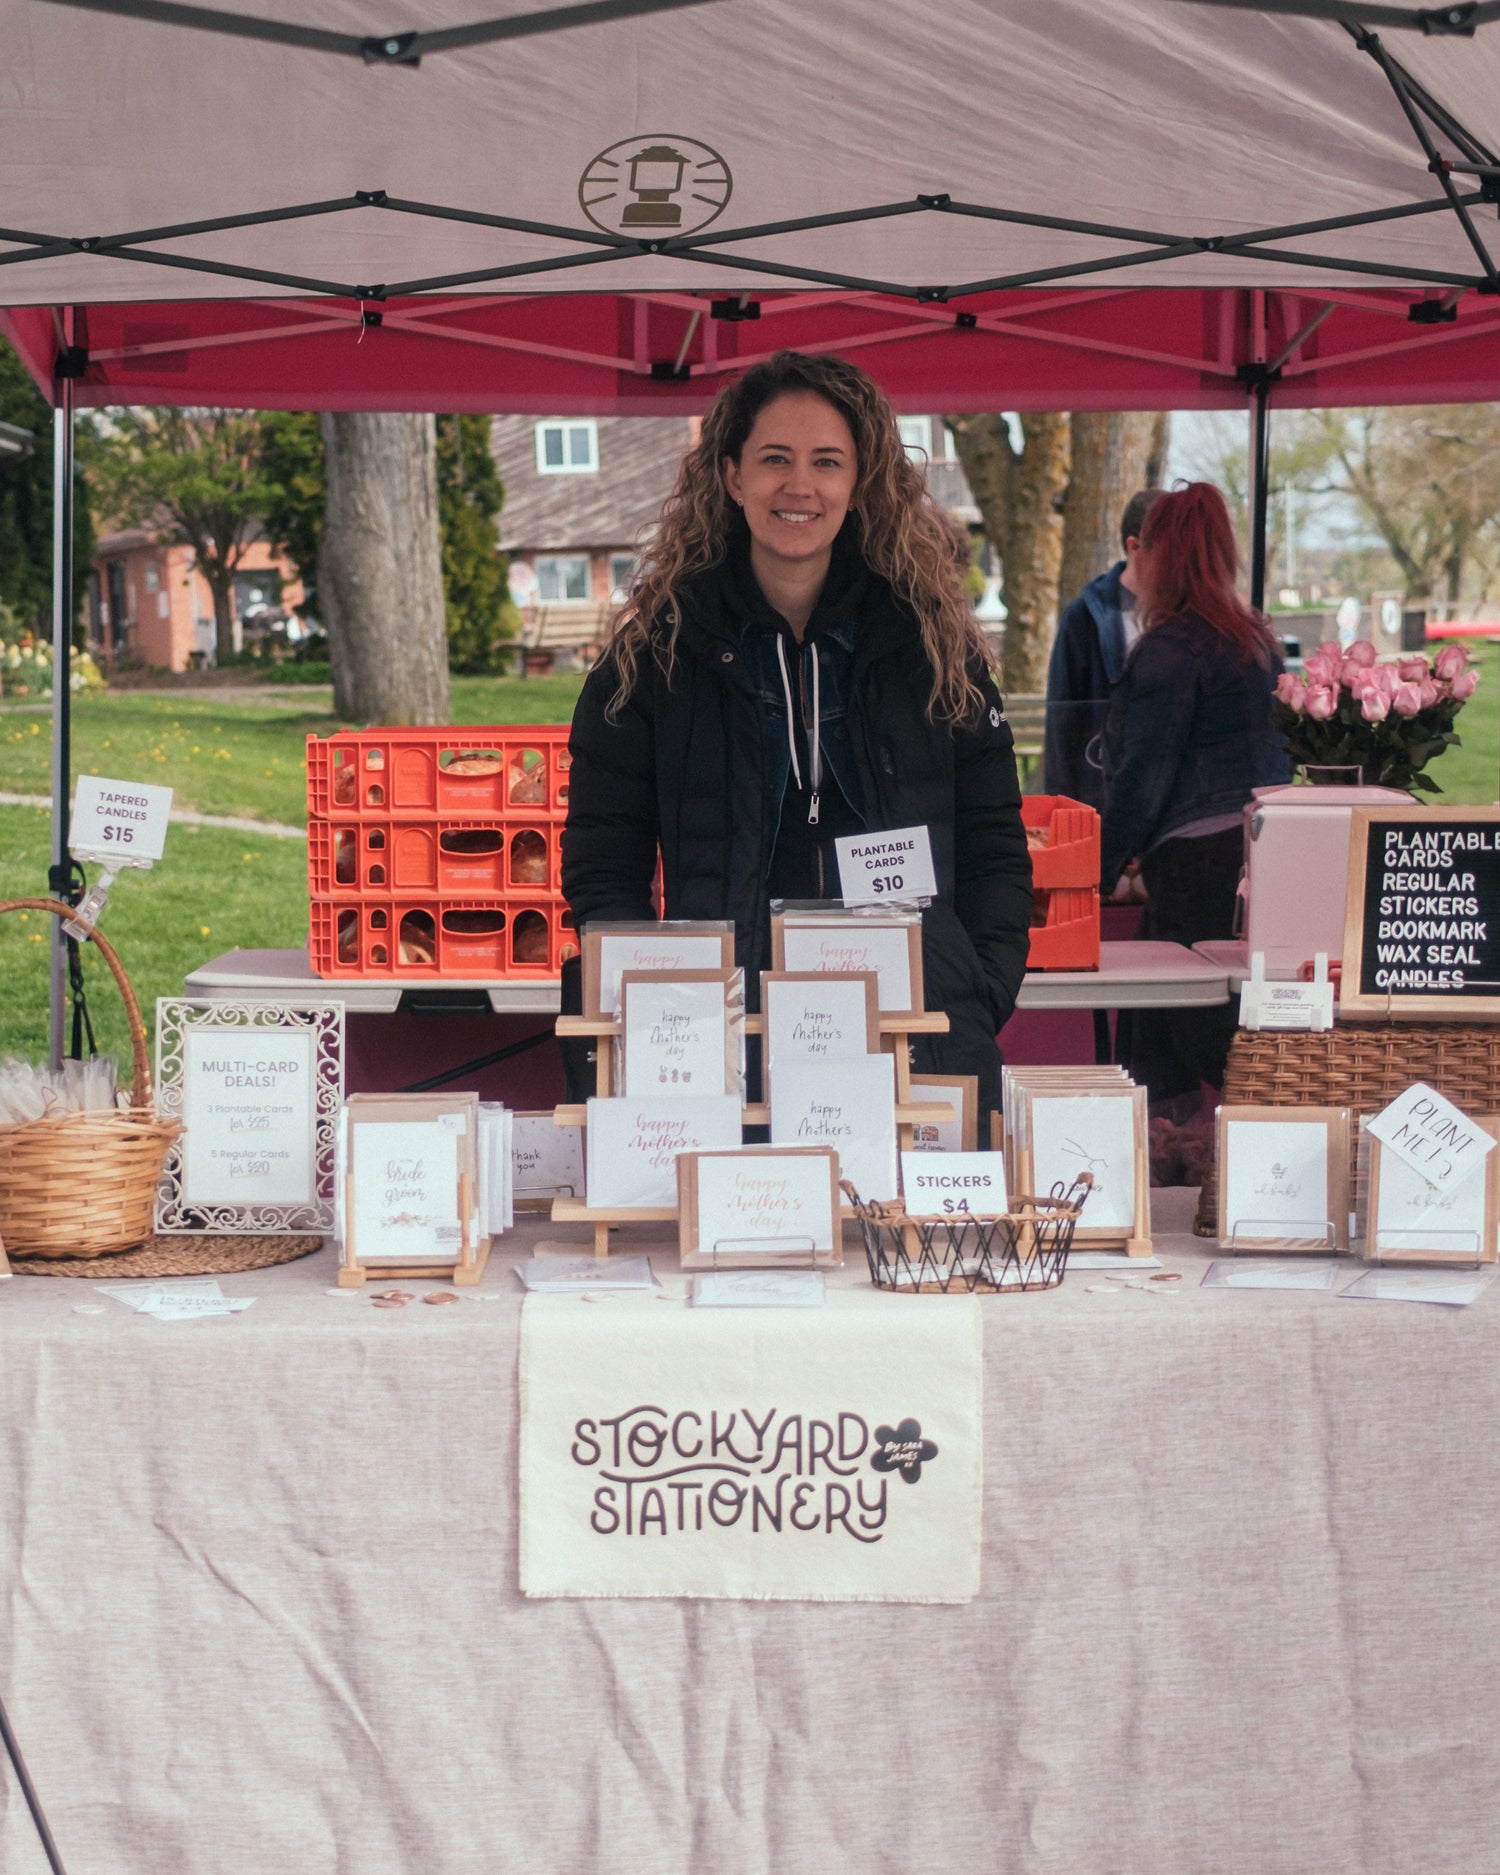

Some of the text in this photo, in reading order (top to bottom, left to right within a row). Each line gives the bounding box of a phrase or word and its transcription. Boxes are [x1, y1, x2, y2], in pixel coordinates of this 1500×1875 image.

[100, 792, 148, 807] TAPERED
[96, 805, 147, 821] CANDLES
[103, 825, 134, 843] $15
[851, 840, 914, 858] PLANTABLE
[865, 855, 904, 869] CARDS
[1384, 849, 1453, 868] CARDS
[872, 874, 903, 894] $10
[1383, 872, 1475, 892] REGULAR
[1379, 896, 1479, 916] STICKERS
[1378, 920, 1487, 941] BOOKMARK
[1377, 944, 1481, 964] WAX SEAL
[1375, 969, 1465, 989] CANDLES
[662, 1009, 690, 1028] happy
[803, 1007, 832, 1025] happy
[665, 1045, 685, 1060] day
[808, 1041, 828, 1056] day
[202, 1061, 299, 1073] MULTI-CARD
[224, 1075, 276, 1088] DEALS!
[207, 1104, 294, 1113] 3 Plantable Cards
[810, 1099, 842, 1119] happy
[636, 1112, 690, 1136] happy
[1408, 1097, 1476, 1154] PLANT
[211, 1149, 290, 1161] 5 Regular Cards
[512, 1148, 542, 1161] thank
[516, 1162, 536, 1176] you
[916, 1175, 993, 1188] STICKERS
[942, 1197, 970, 1214] $4
[571, 1404, 869, 1476] STOCKYARD
[590, 1472, 887, 1543] STATIONERY
